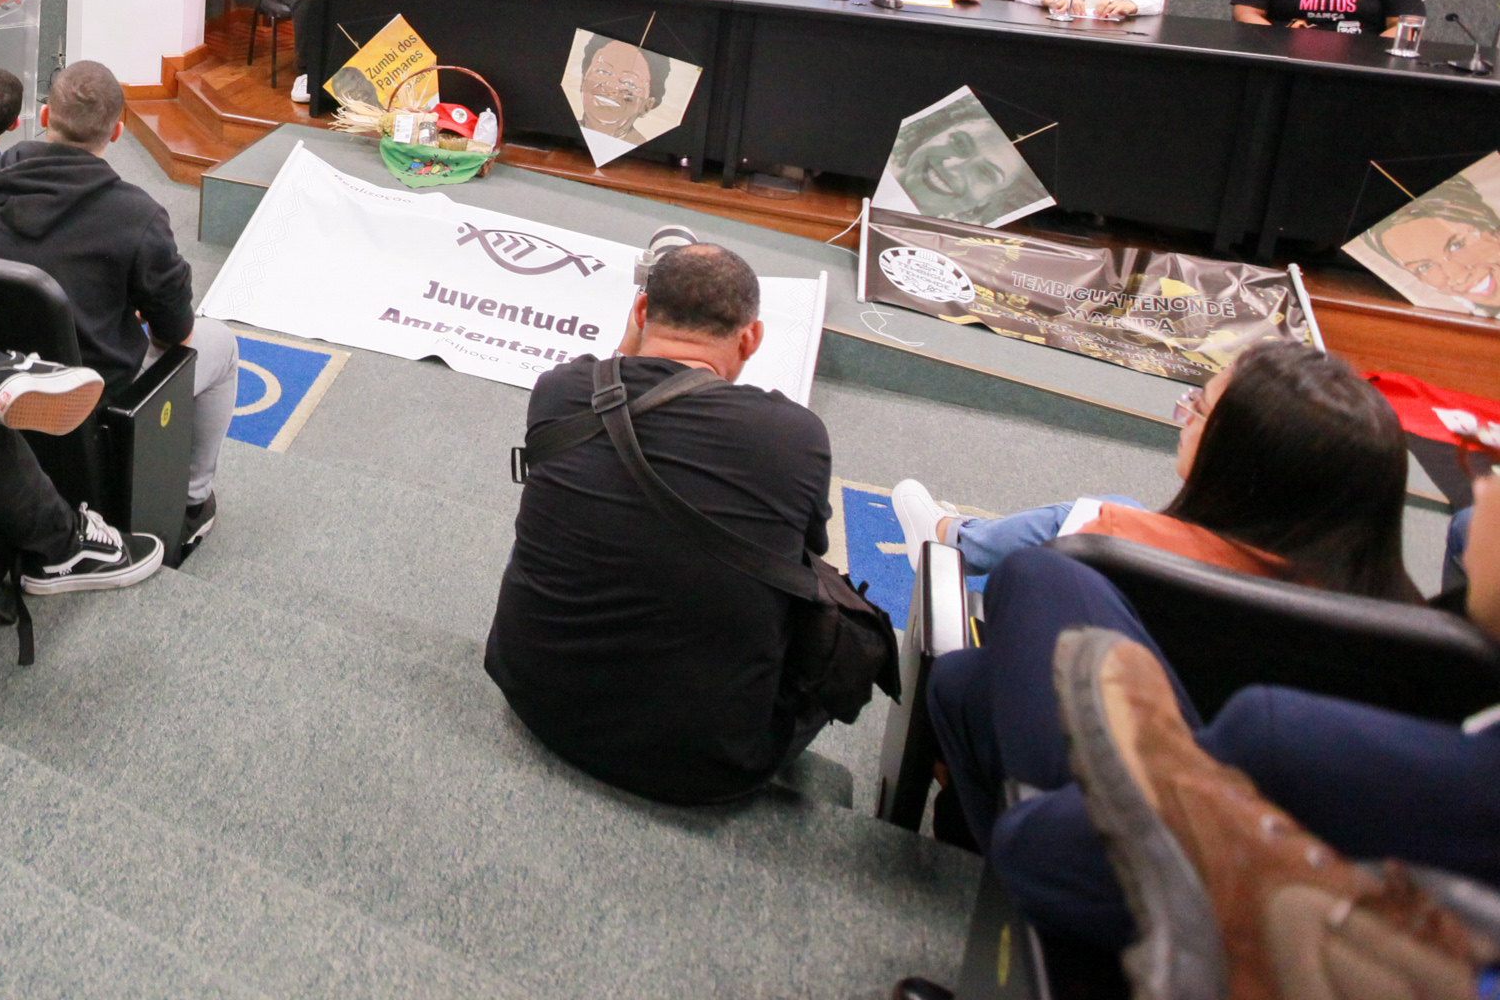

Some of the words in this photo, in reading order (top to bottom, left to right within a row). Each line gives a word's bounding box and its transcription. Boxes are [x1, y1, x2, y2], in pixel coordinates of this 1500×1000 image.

[365, 49, 399, 80] Zumbi
[398, 33, 418, 54] dos
[375, 49, 424, 91] Palmares
[422, 280, 600, 341] Juventude
[1011, 271, 1126, 310] TEMBIGUAI
[518, 360, 546, 375] SC
